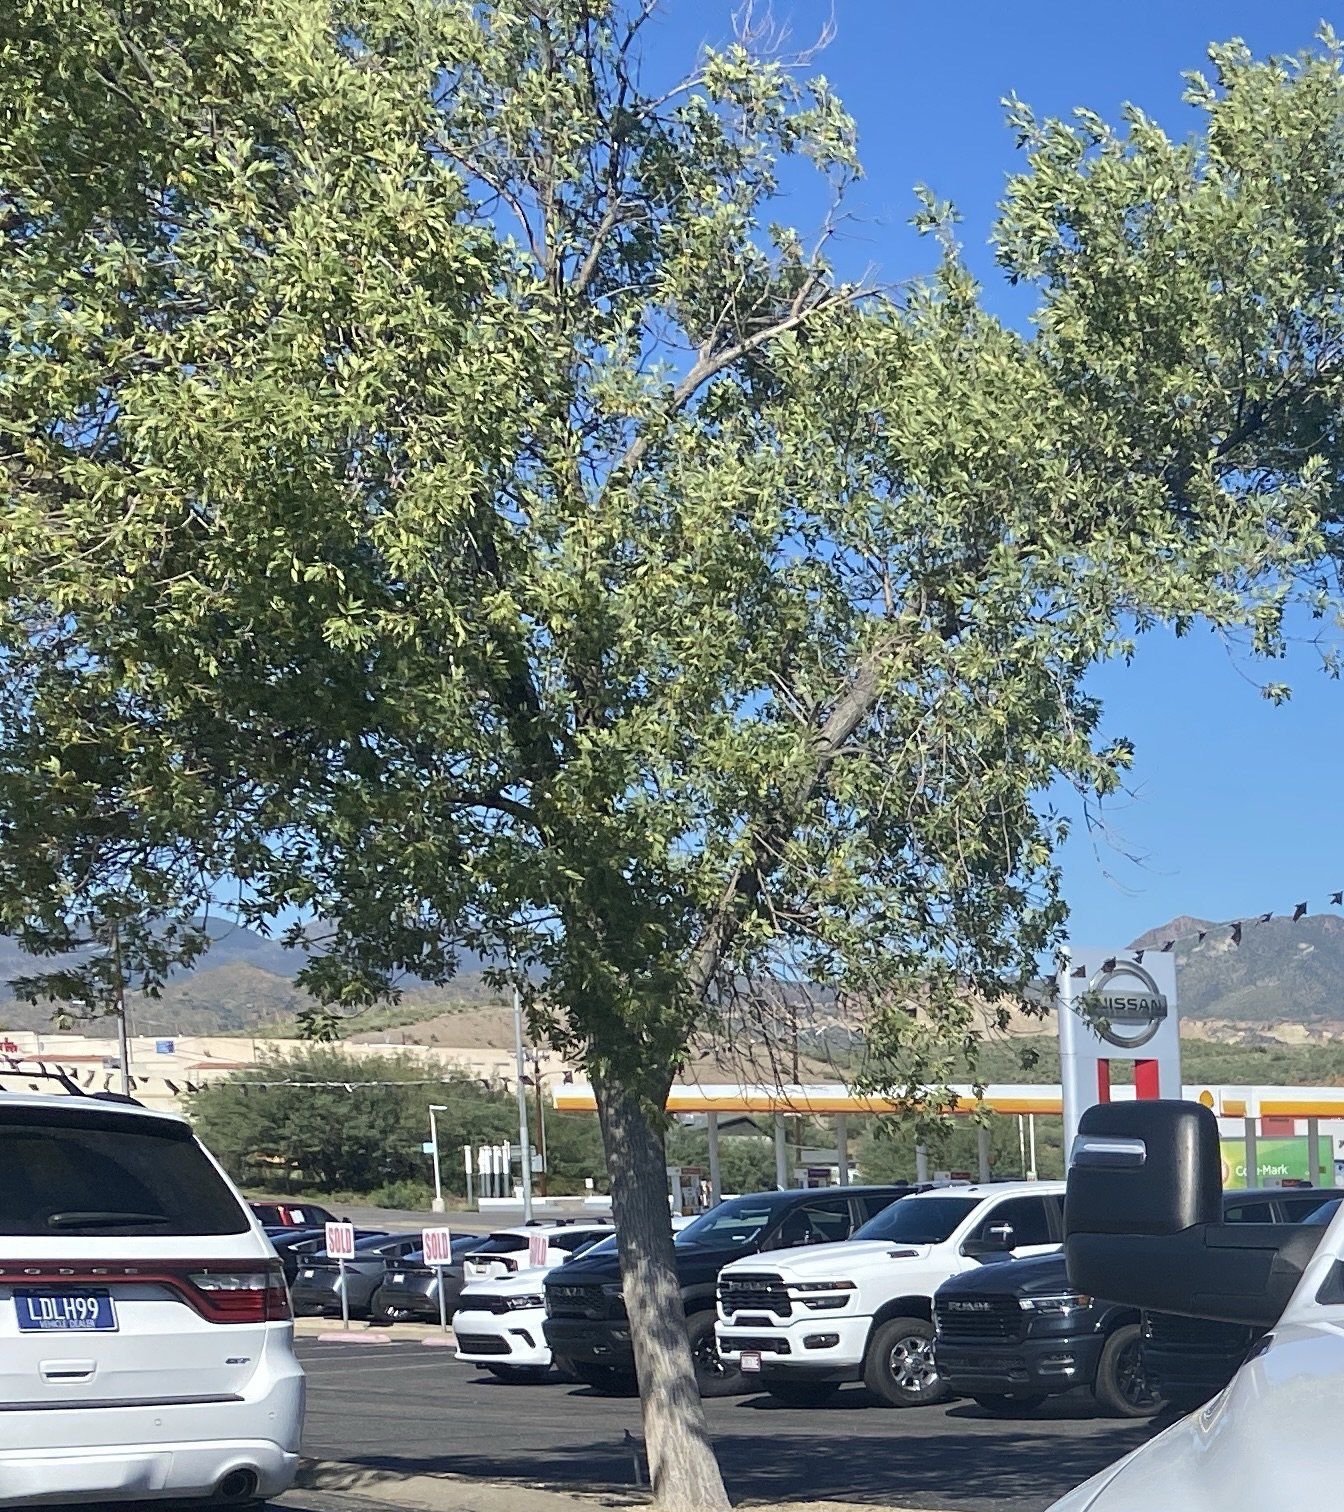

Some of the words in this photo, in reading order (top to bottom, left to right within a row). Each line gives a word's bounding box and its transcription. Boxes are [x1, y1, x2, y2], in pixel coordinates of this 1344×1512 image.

[328, 1227, 352, 1254] SOLD
[424, 1232, 449, 1261] SOLD
[27, 1297, 100, 1321] LDLH99
